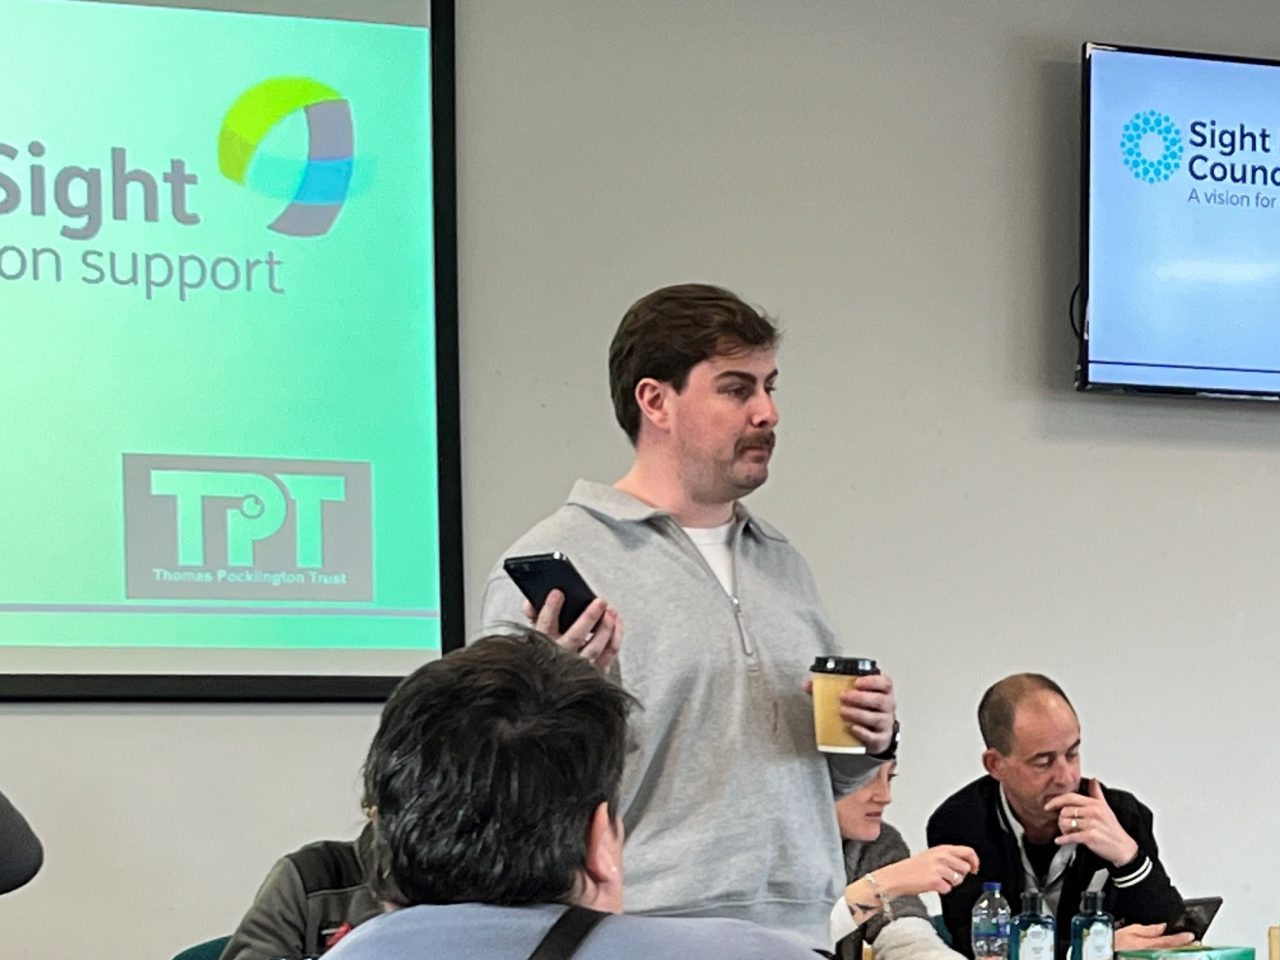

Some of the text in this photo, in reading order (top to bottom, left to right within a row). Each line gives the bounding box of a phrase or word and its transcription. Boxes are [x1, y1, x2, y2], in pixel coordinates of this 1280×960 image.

[1188, 119, 1271, 157] Sight
[1187, 187, 1201, 204] A
[1203, 188, 1250, 207] vision
[1254, 191, 1277, 209] for
[81, 248, 285, 301] support
[150, 469, 346, 568] TPT
[152, 568, 347, 586] Thomas Pocklington Trust
